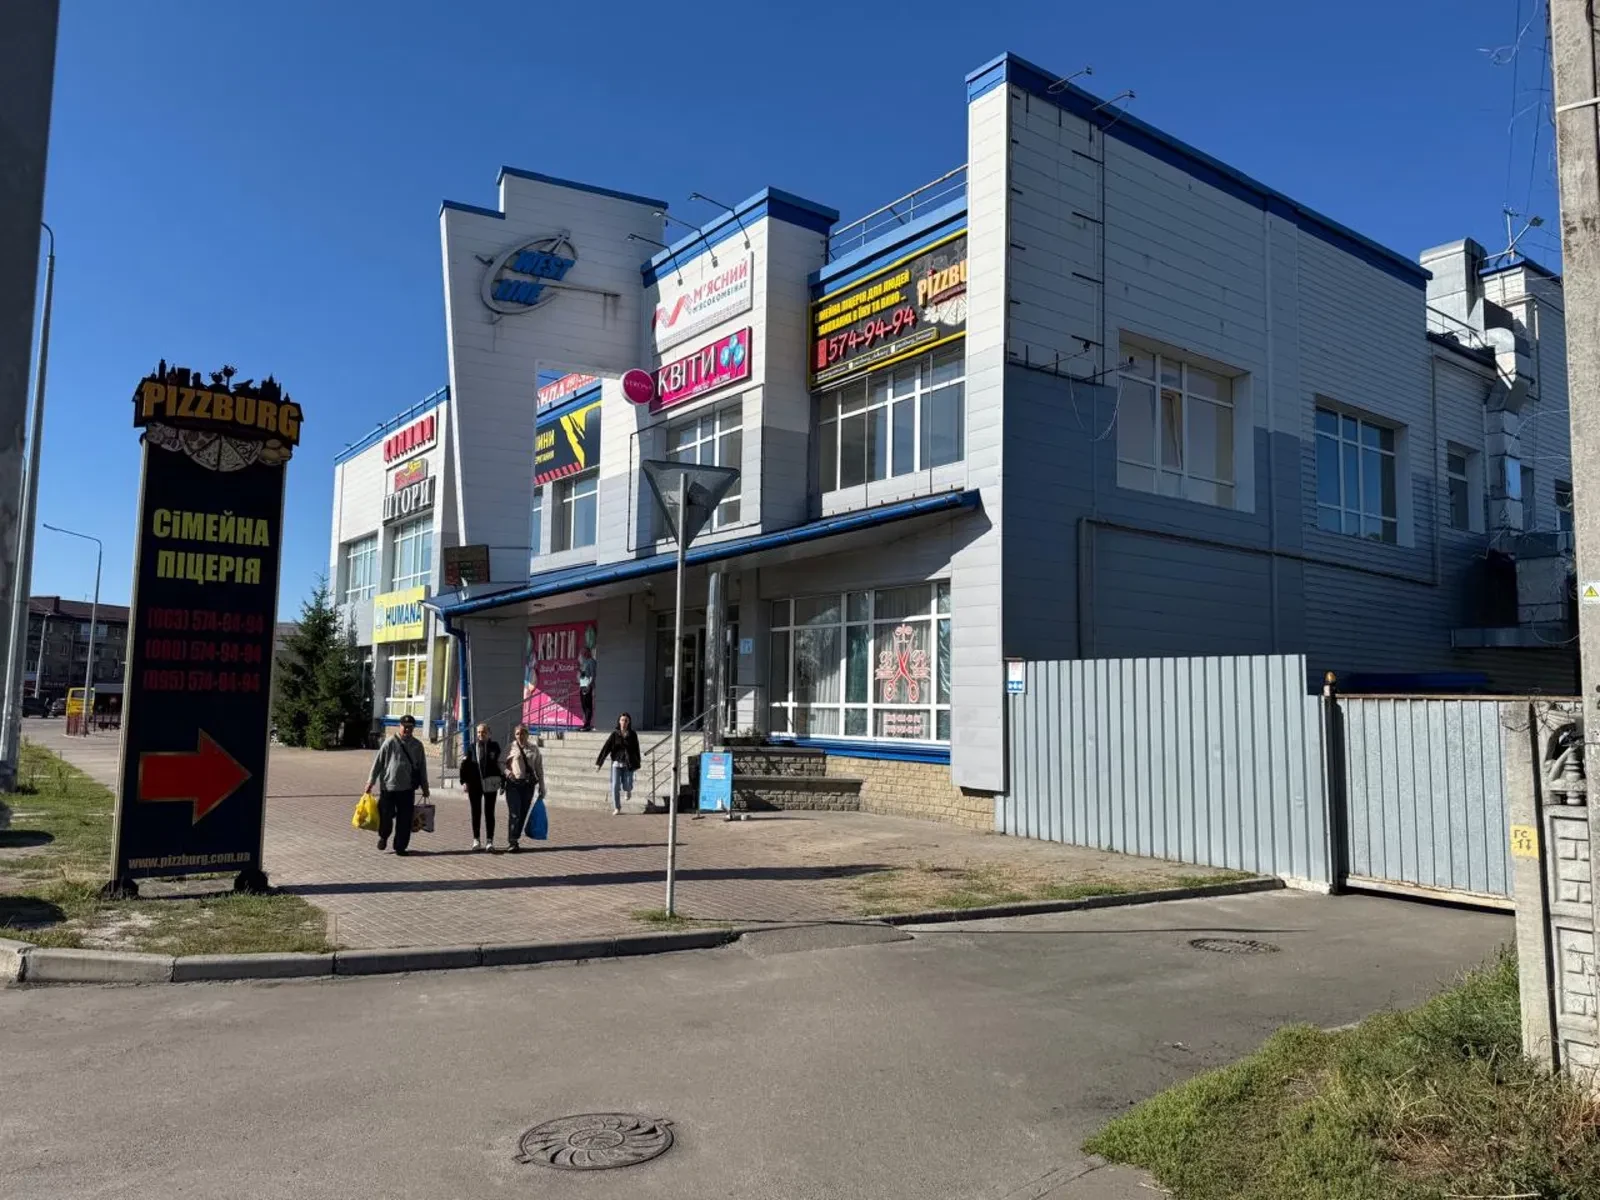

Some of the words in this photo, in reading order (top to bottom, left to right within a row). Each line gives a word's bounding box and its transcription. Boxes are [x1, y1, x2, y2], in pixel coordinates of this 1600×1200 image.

[693, 258, 748, 304] М'ЯСНИЙ
[828, 306, 916, 361] 574-94-94
[657, 345, 716, 396] КВІТИ
[142, 381, 301, 440] PIZZBURG
[156, 550, 261, 585] ПІЦЕРІЯ
[385, 601, 421, 627] HUMANA
[537, 629, 576, 660] КВІТИ
[127, 850, 251, 869] www.pizzburg.com.ua
